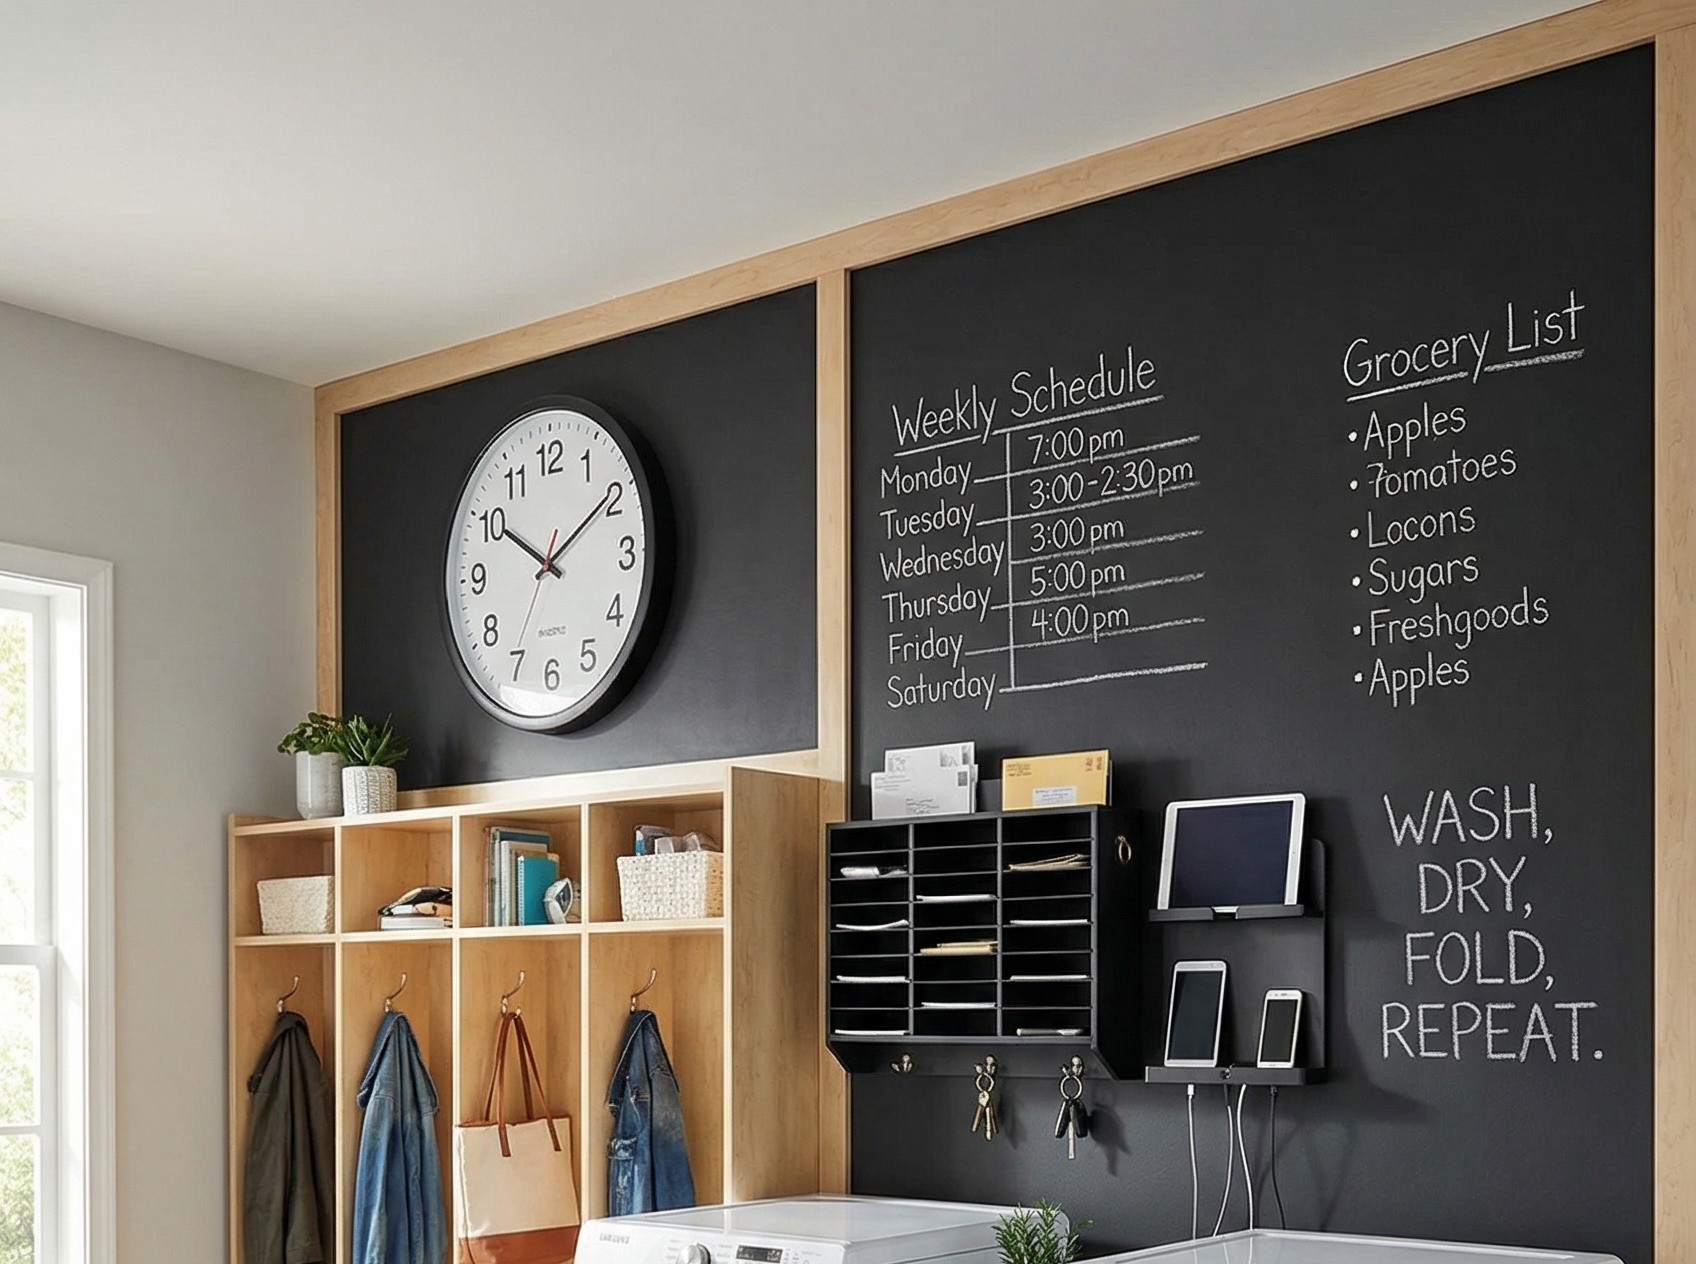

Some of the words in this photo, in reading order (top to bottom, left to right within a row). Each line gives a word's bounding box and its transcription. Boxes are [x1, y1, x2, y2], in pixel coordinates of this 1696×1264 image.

[1343, 330, 1490, 384] Grocery
[1507, 290, 1586, 352] List
[892, 384, 997, 445] Weekly
[1010, 346, 1156, 418] Schedule
[1364, 401, 1467, 460] Apples
[536, 439, 564, 477] 12
[580, 448, 591, 483] 1
[880, 456, 972, 499] Monday
[504, 464, 526, 500] 11
[605, 481, 624, 518] 2
[479, 507, 506, 543] 10
[880, 499, 975, 540] Tuesday
[1368, 506, 1476, 548] Locons
[618, 535, 636, 571] 3
[880, 536, 1005, 582] Wednesday
[471, 562, 487, 596] 9
[1368, 555, 1480, 604] Sugars
[605, 593, 624, 628] 4
[881, 582, 992, 623] Thursday
[1370, 586, 1549, 651] Freshgoods
[483, 613, 499, 647] 8
[888, 628, 963, 668] Friday
[509, 649, 526, 683] 7
[544, 658, 560, 692] 6
[580, 638, 597, 673] 5
[887, 667, 997, 711] Saturday
[1369, 651, 1470, 709] Apples
[1383, 782, 1553, 847] WASH,
[1418, 856, 1533, 919] DRY,
[1405, 929, 1554, 990] FOLD,
[1381, 1001, 1603, 1063] REPEAT.
